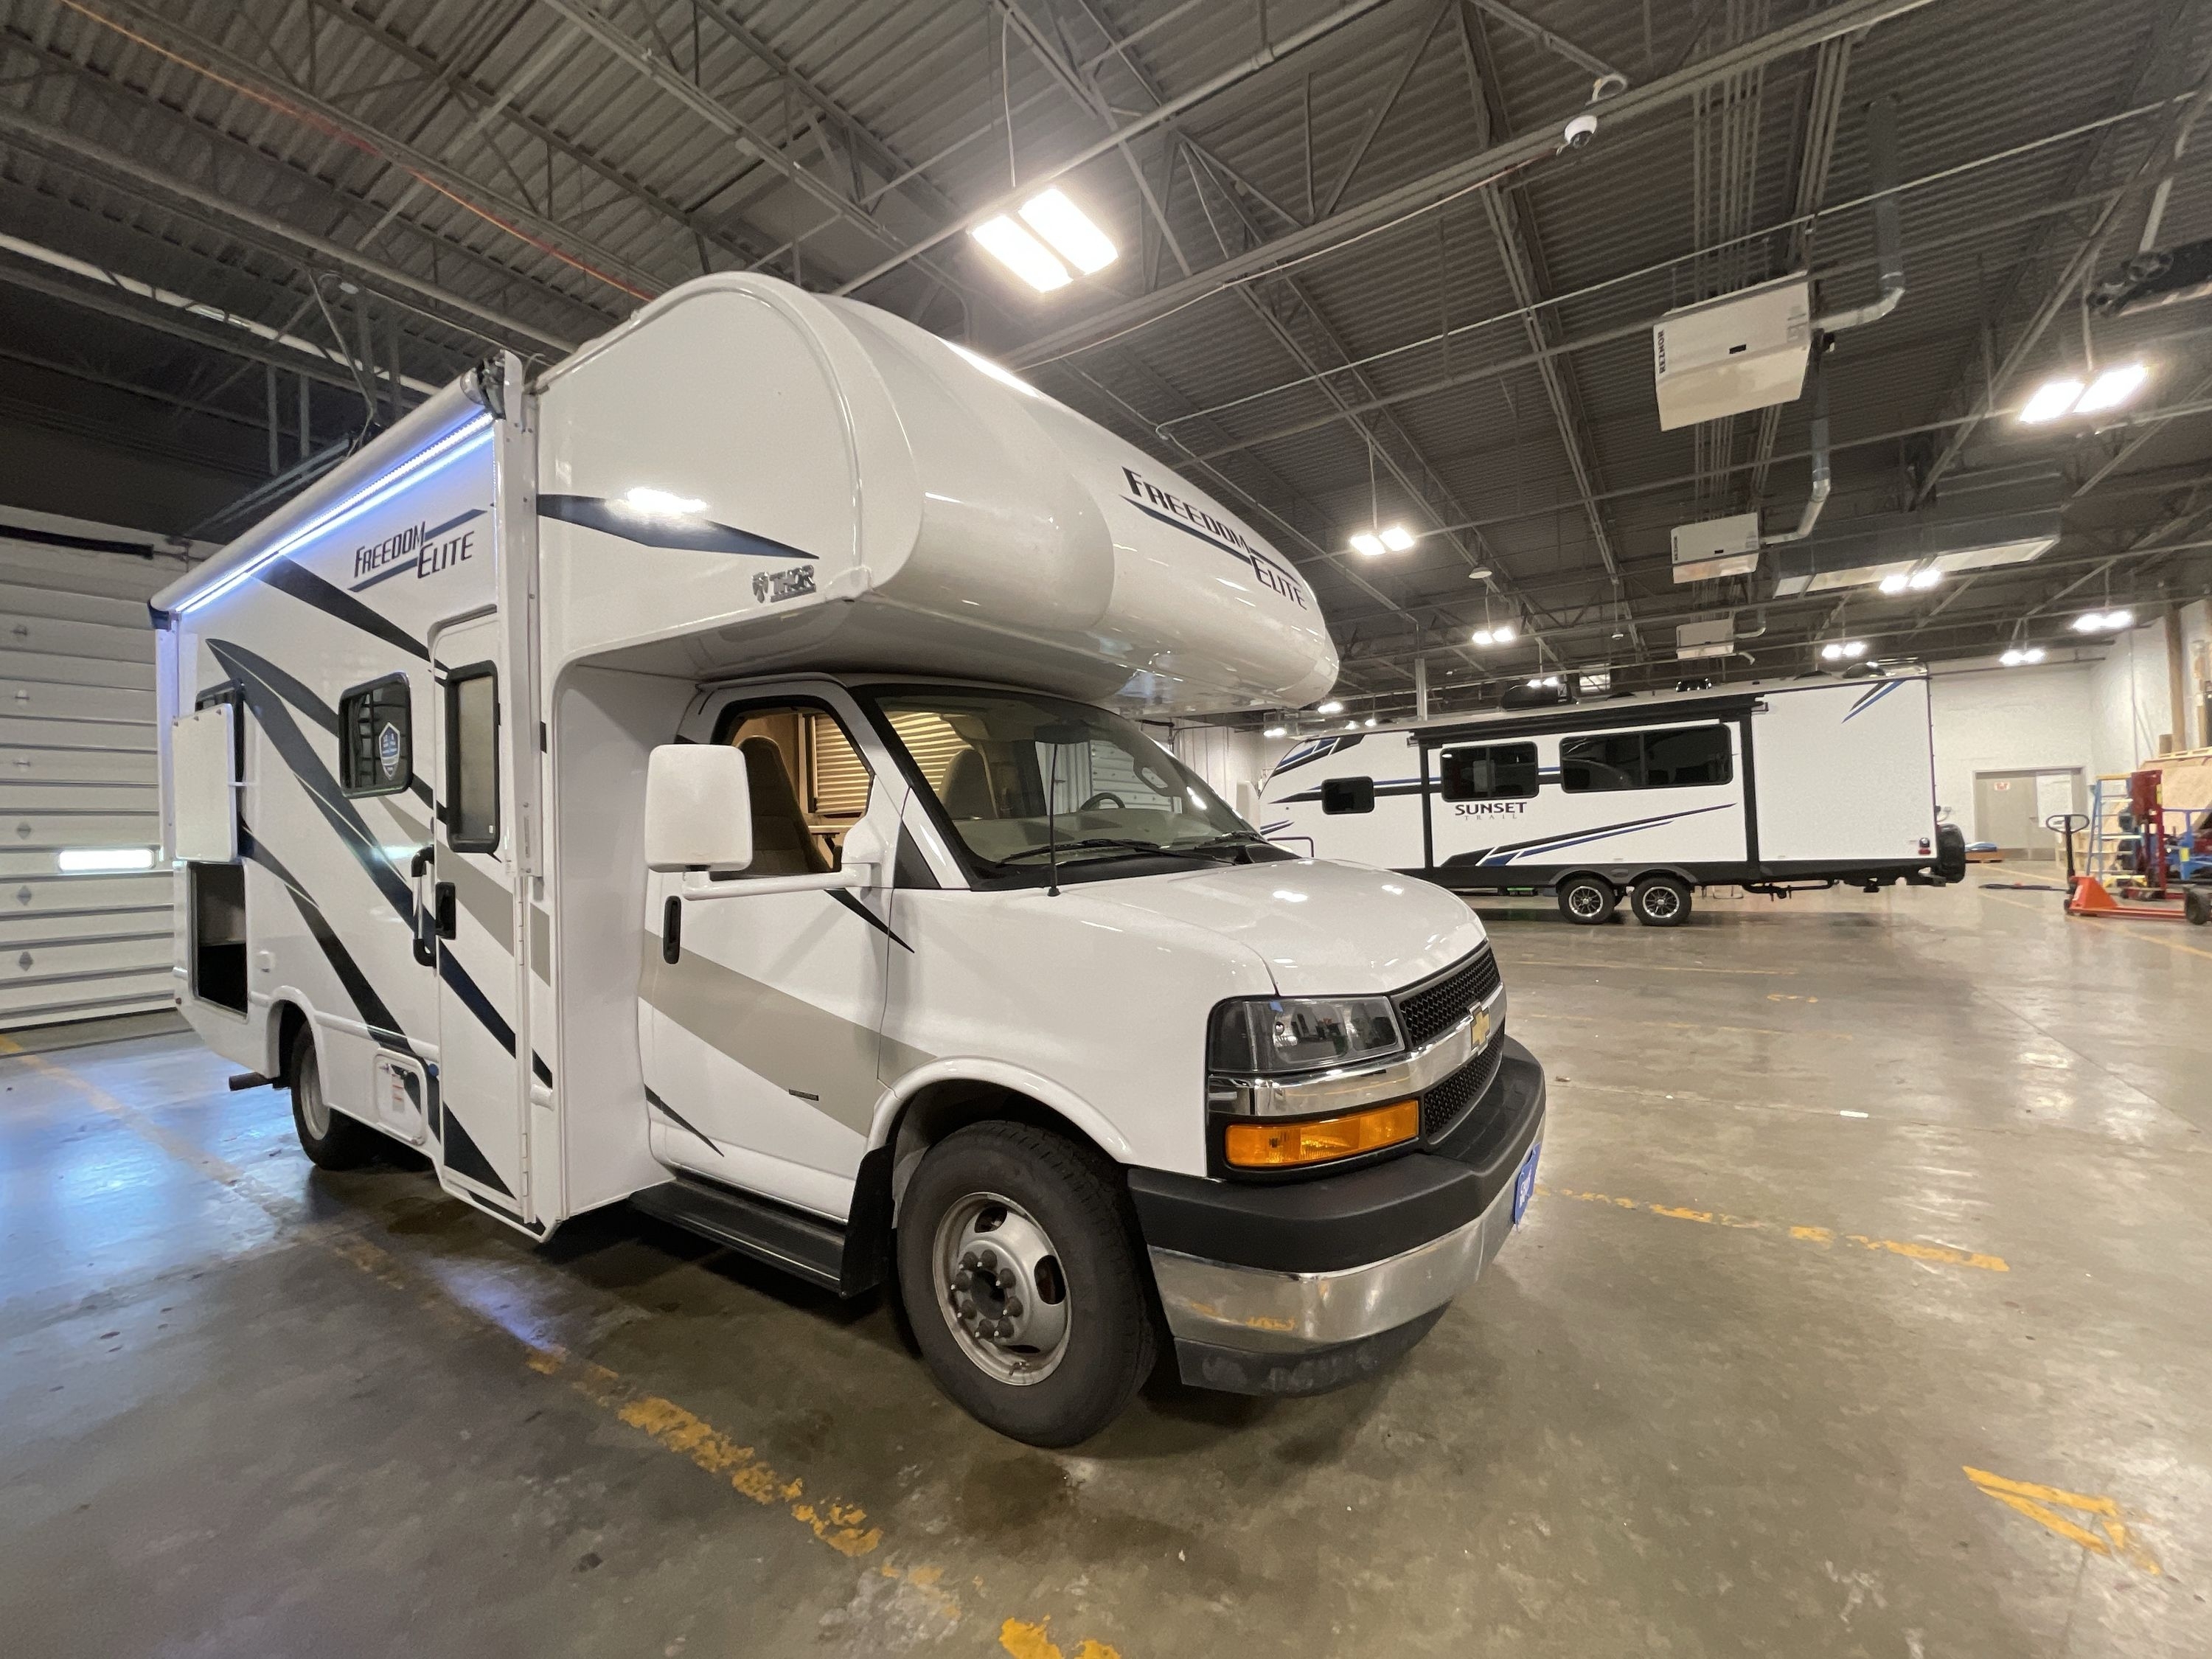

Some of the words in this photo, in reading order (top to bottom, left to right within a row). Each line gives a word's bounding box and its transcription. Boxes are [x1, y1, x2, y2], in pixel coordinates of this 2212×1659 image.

[1658, 329, 1666, 374] REZNOR
[1121, 466, 1251, 553] FREEDOM
[355, 521, 425, 578] FREEDOM
[417, 531, 474, 579] ELITE
[1250, 554, 1307, 611] ELITE
[1455, 802, 1527, 815] SUNSET
